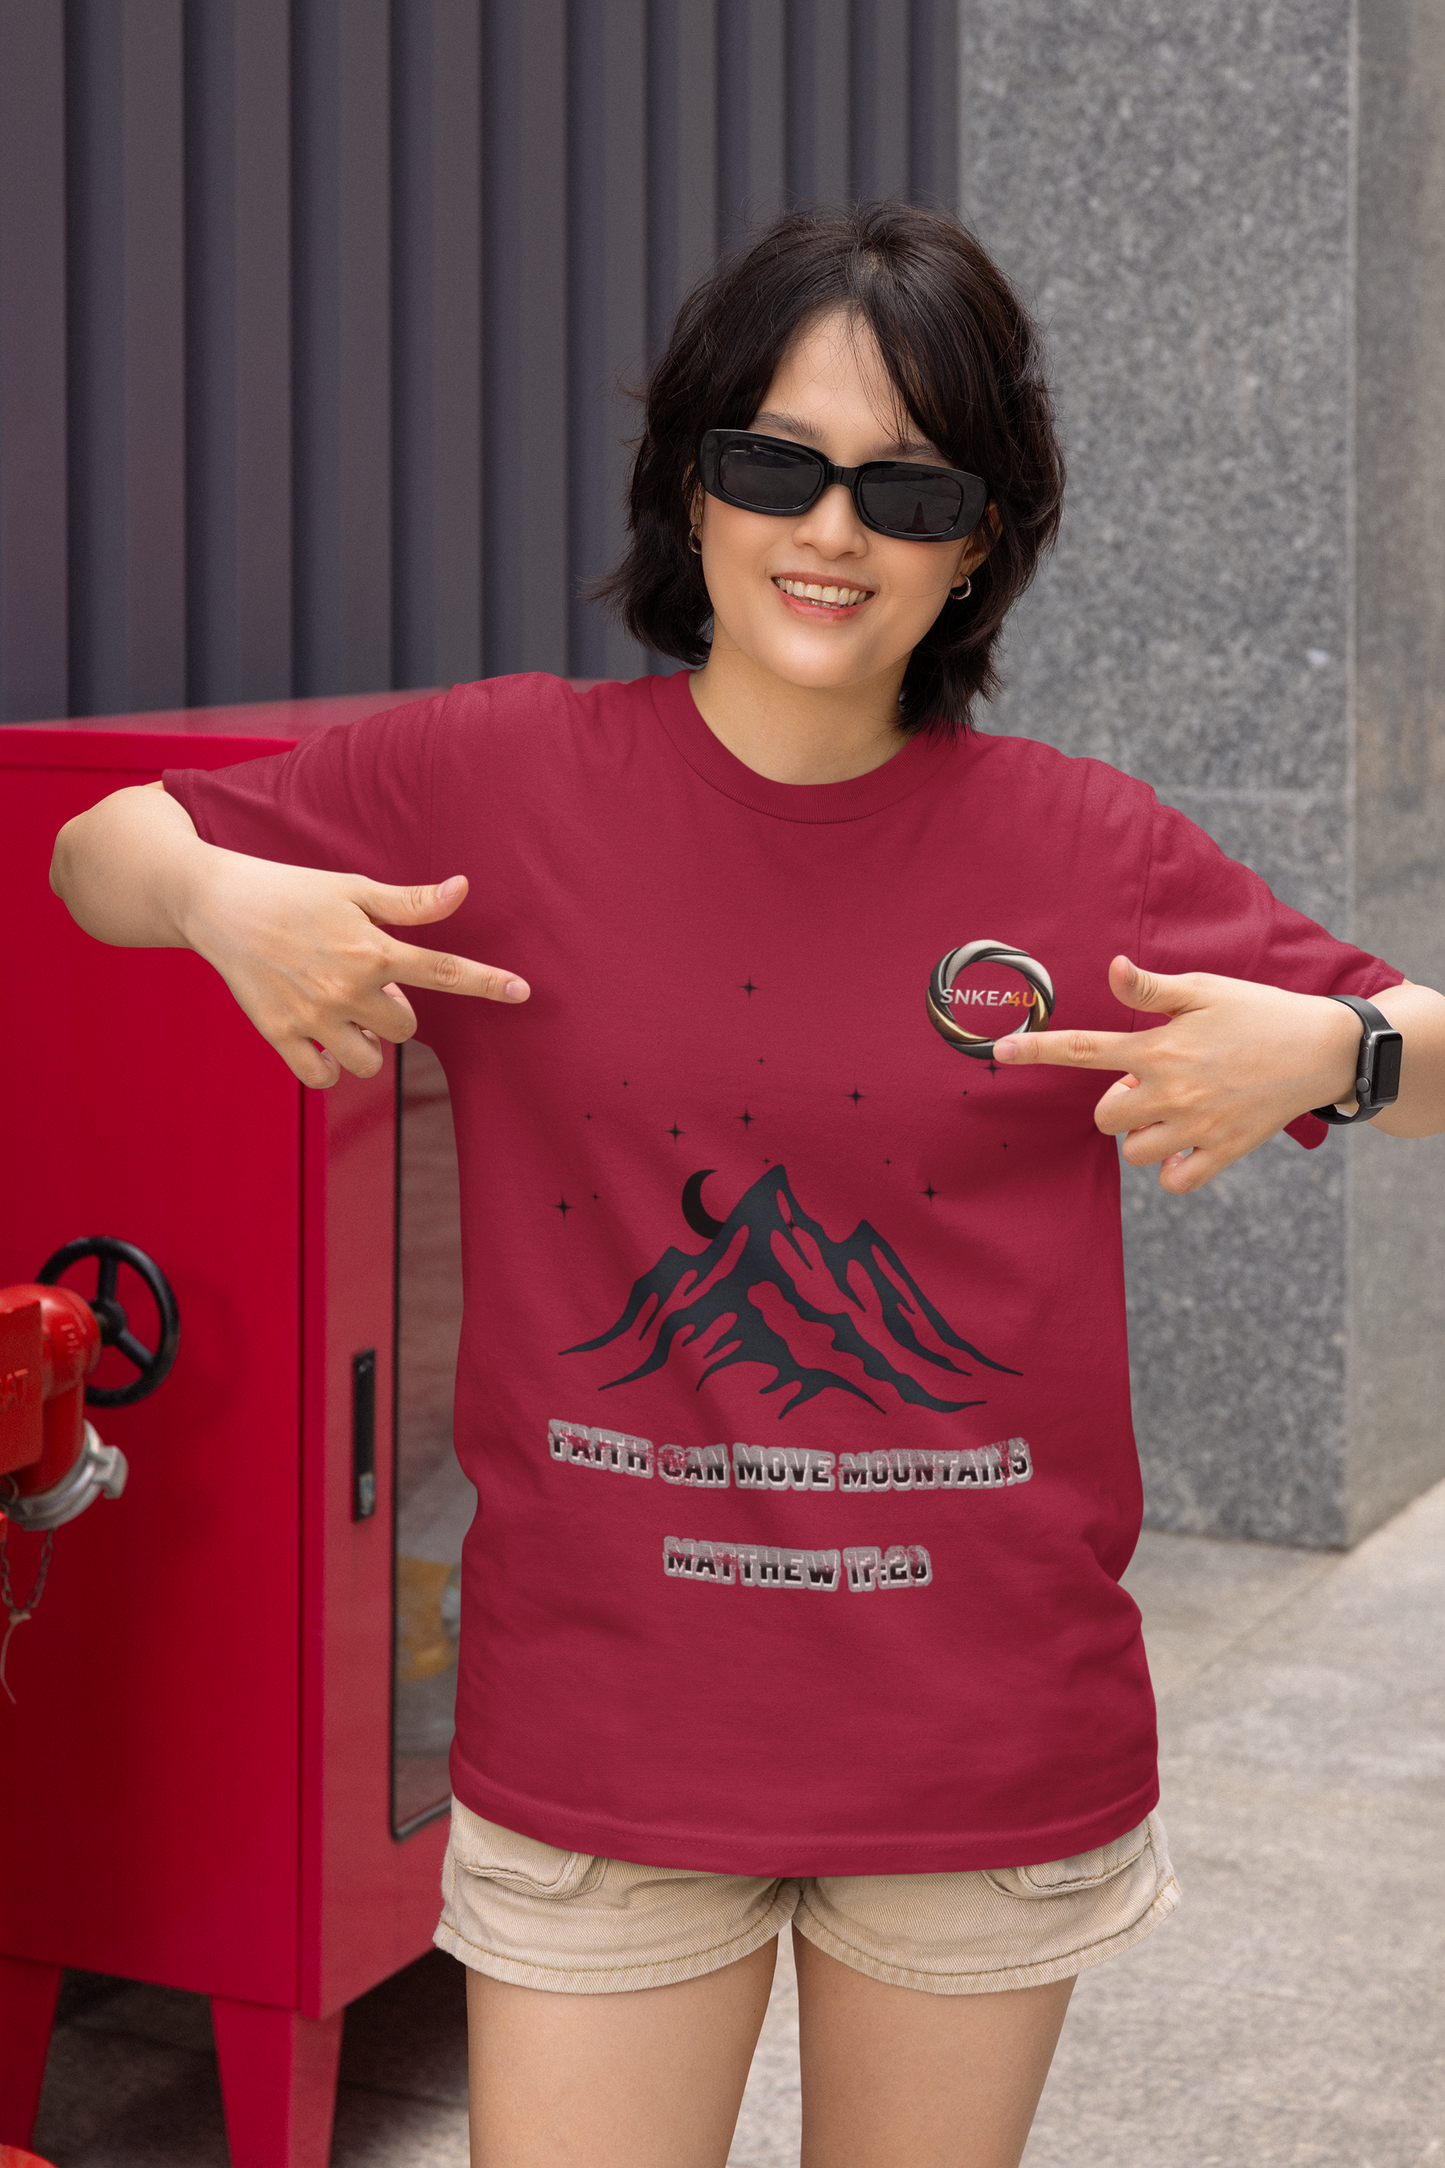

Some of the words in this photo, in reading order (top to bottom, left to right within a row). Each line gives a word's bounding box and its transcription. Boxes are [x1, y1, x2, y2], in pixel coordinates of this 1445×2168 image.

[549, 1419, 654, 1479] FAITH
[658, 1444, 731, 1489] CAN
[732, 1442, 836, 1491] MOVE
[838, 1437, 1033, 1492] MOUNTAINS
[663, 1536, 841, 1592] MATTHEW
[843, 1545, 933, 1592] 17:20
